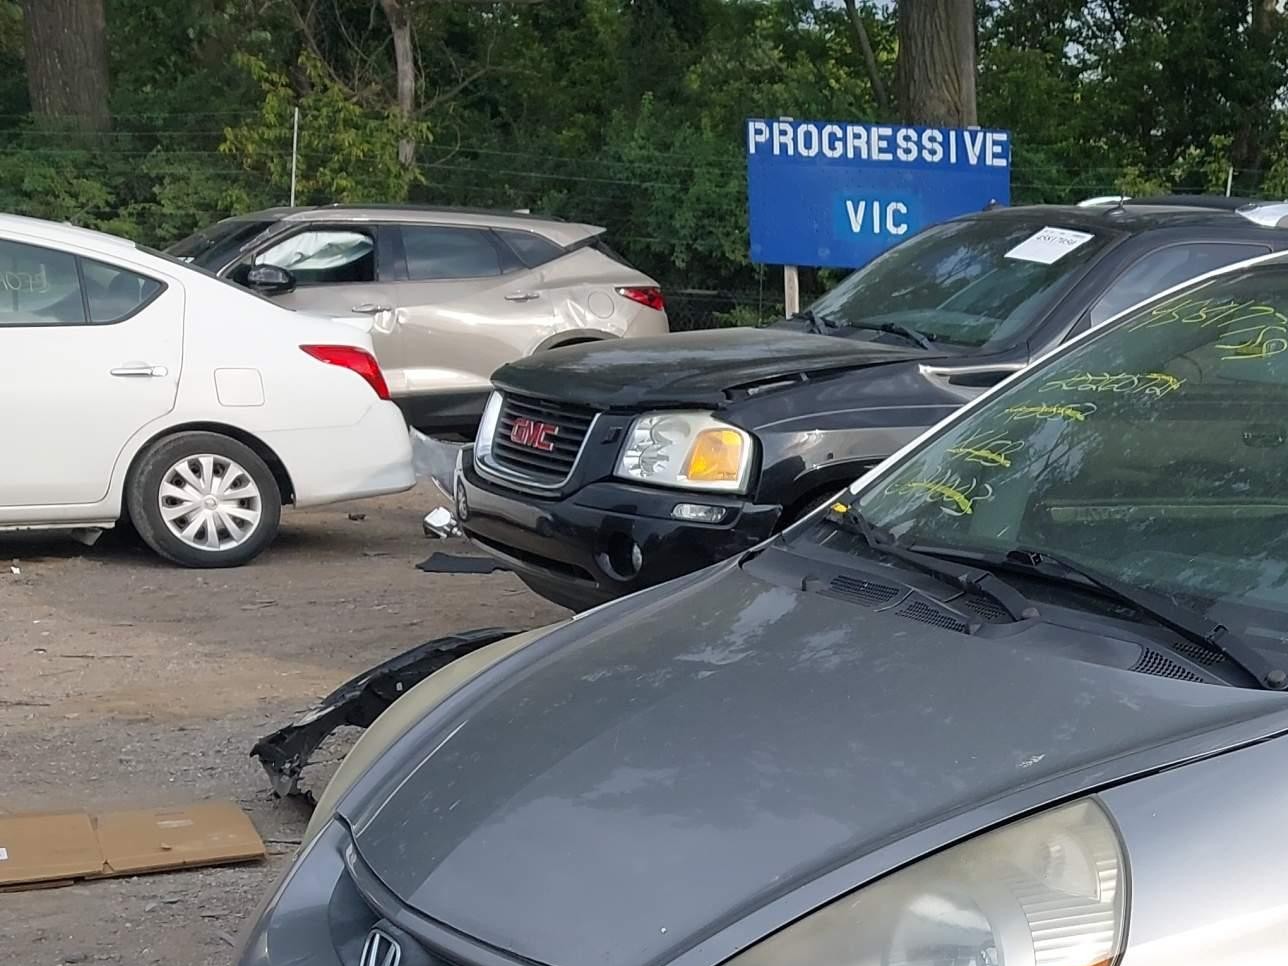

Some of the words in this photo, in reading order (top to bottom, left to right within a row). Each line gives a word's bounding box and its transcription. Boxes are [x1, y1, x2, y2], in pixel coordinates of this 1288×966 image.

[748, 121, 1008, 167] PROGRESSIVE
[846, 200, 908, 235] VIC
[511, 418, 559, 451] GMC
